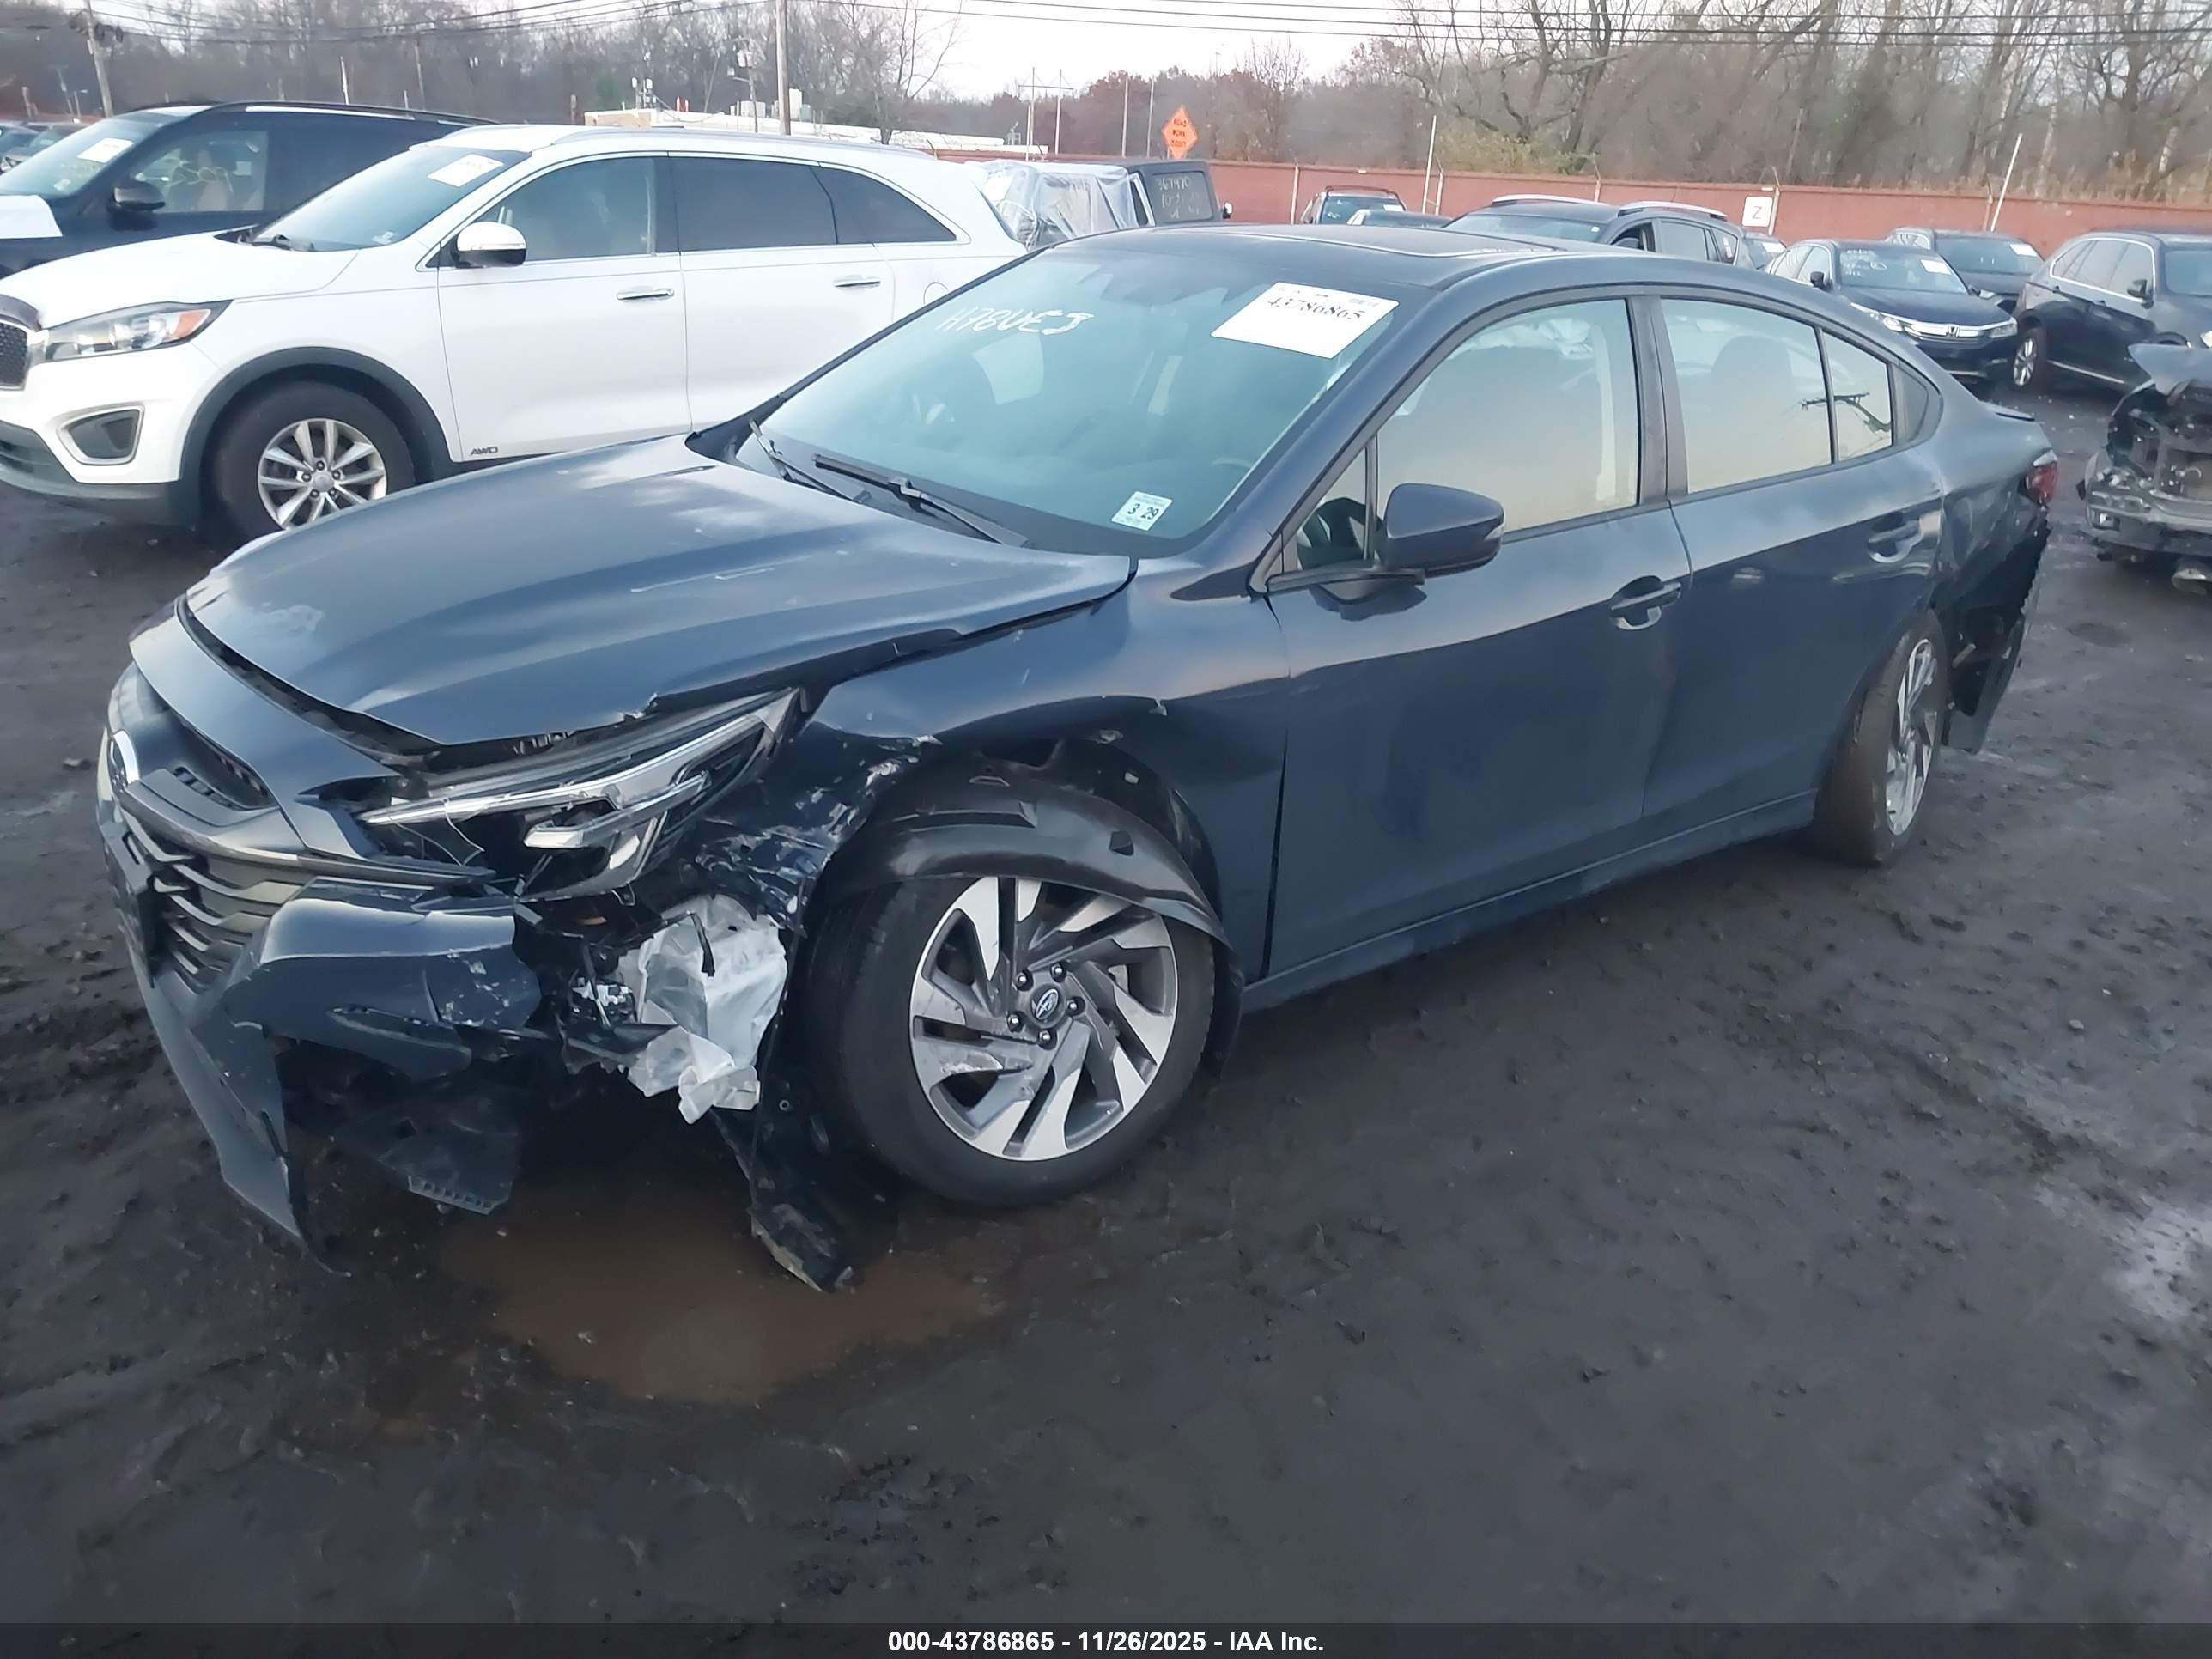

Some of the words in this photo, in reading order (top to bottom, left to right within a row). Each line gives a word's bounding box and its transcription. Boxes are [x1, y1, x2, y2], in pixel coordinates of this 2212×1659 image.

[470, 446, 499, 456] AWD
[1127, 503, 1141, 515] 3
[1140, 507, 1159, 520] 29
